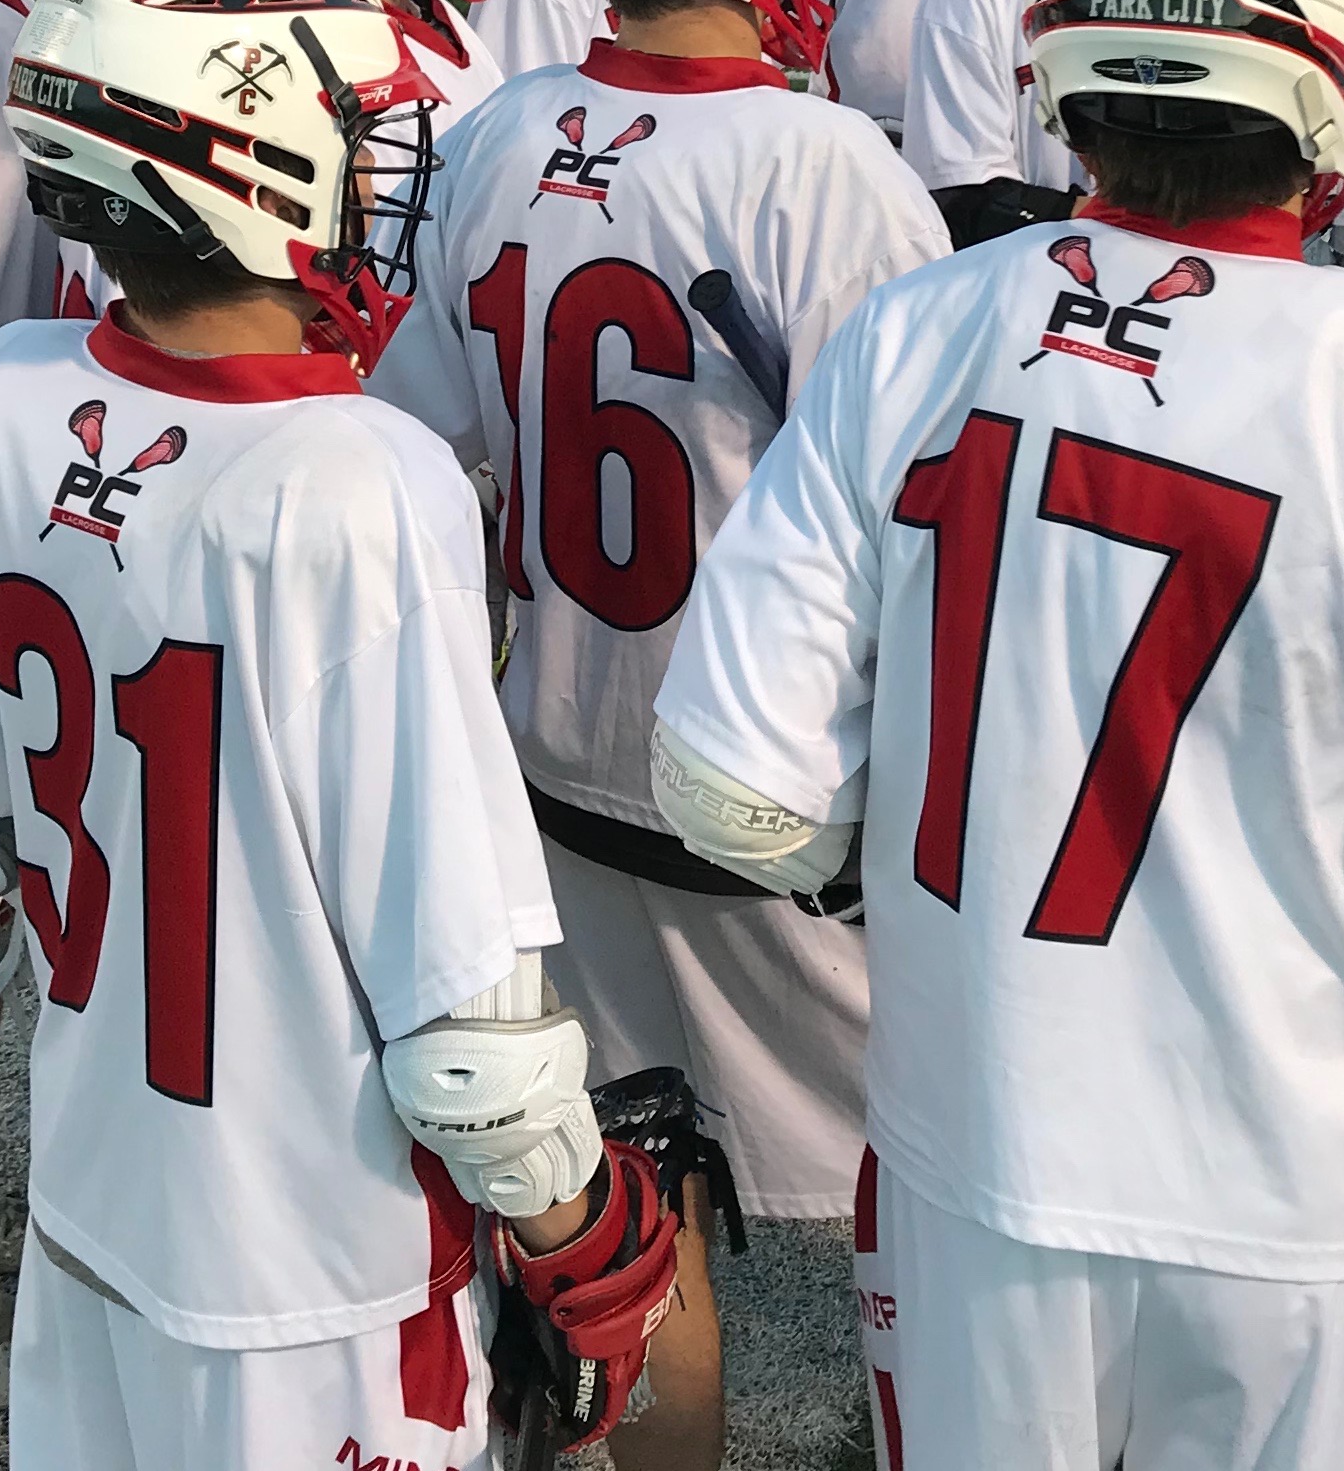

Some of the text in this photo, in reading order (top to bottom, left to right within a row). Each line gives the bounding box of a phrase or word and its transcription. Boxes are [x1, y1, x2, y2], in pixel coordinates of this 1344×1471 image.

[37, 73, 80, 111] CITY
[542, 148, 622, 190] PC
[549, 184, 595, 198] LACROSSE
[1045, 290, 1172, 362] PC
[1060, 341, 1137, 369] LACROSSE
[468, 241, 696, 632] 16
[54, 461, 143, 527] PC
[61, 513, 107, 536] LACROSSE
[892, 408, 1282, 947] 17
[650, 731, 804, 832] MAVERIK
[411, 1108, 527, 1133] TRUE
[573, 1358, 596, 1423] BRINE
